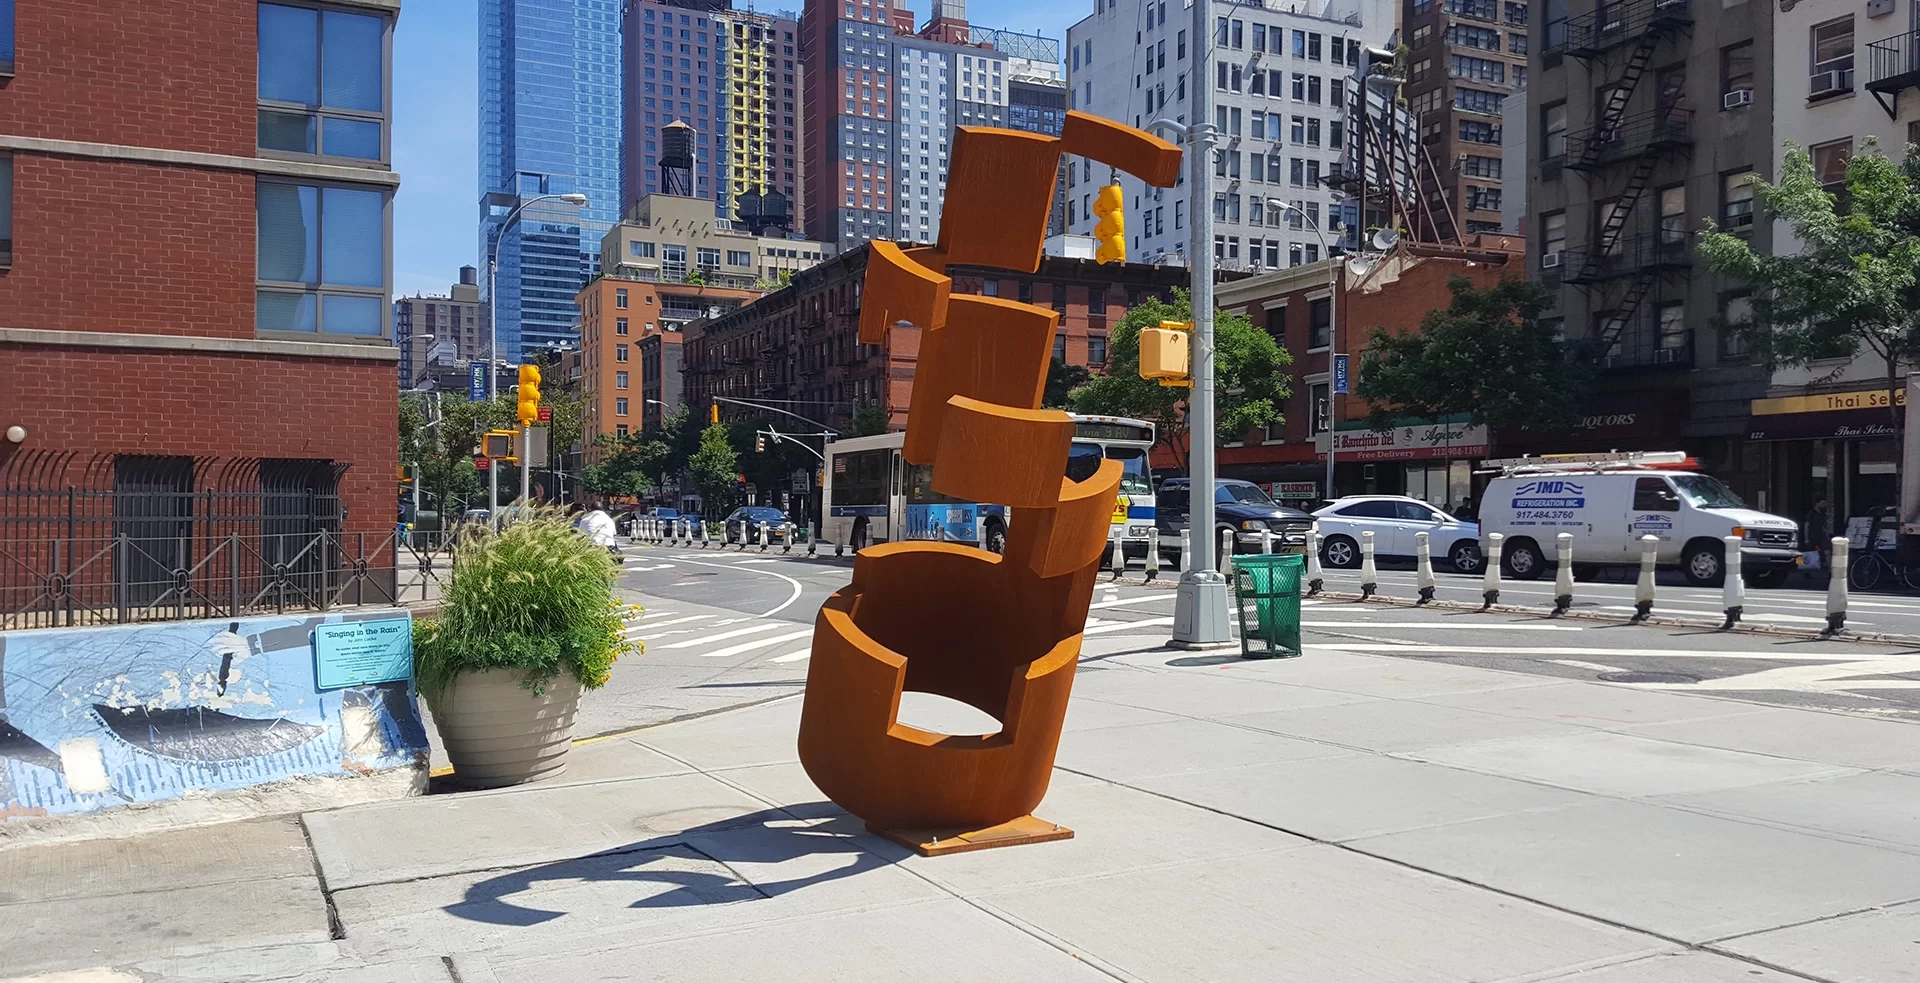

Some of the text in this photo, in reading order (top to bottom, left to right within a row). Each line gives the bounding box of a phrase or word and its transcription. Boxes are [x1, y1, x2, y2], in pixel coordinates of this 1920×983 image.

[1827, 395, 1860, 408] Thai
[1105, 426, 1112, 438] 9
[1115, 427, 1129, 438] AV
[1835, 425, 1862, 436] Thai
[1357, 451, 1375, 459] Free
[1377, 450, 1416, 458] Delivery
[1535, 481, 1564, 494] JMD
[1516, 499, 1565, 507] REFRIGERATION
[1516, 510, 1574, 519] 917.484.3760
[325, 630, 355, 639] "Singing
[380, 626, 401, 634] Rain"
